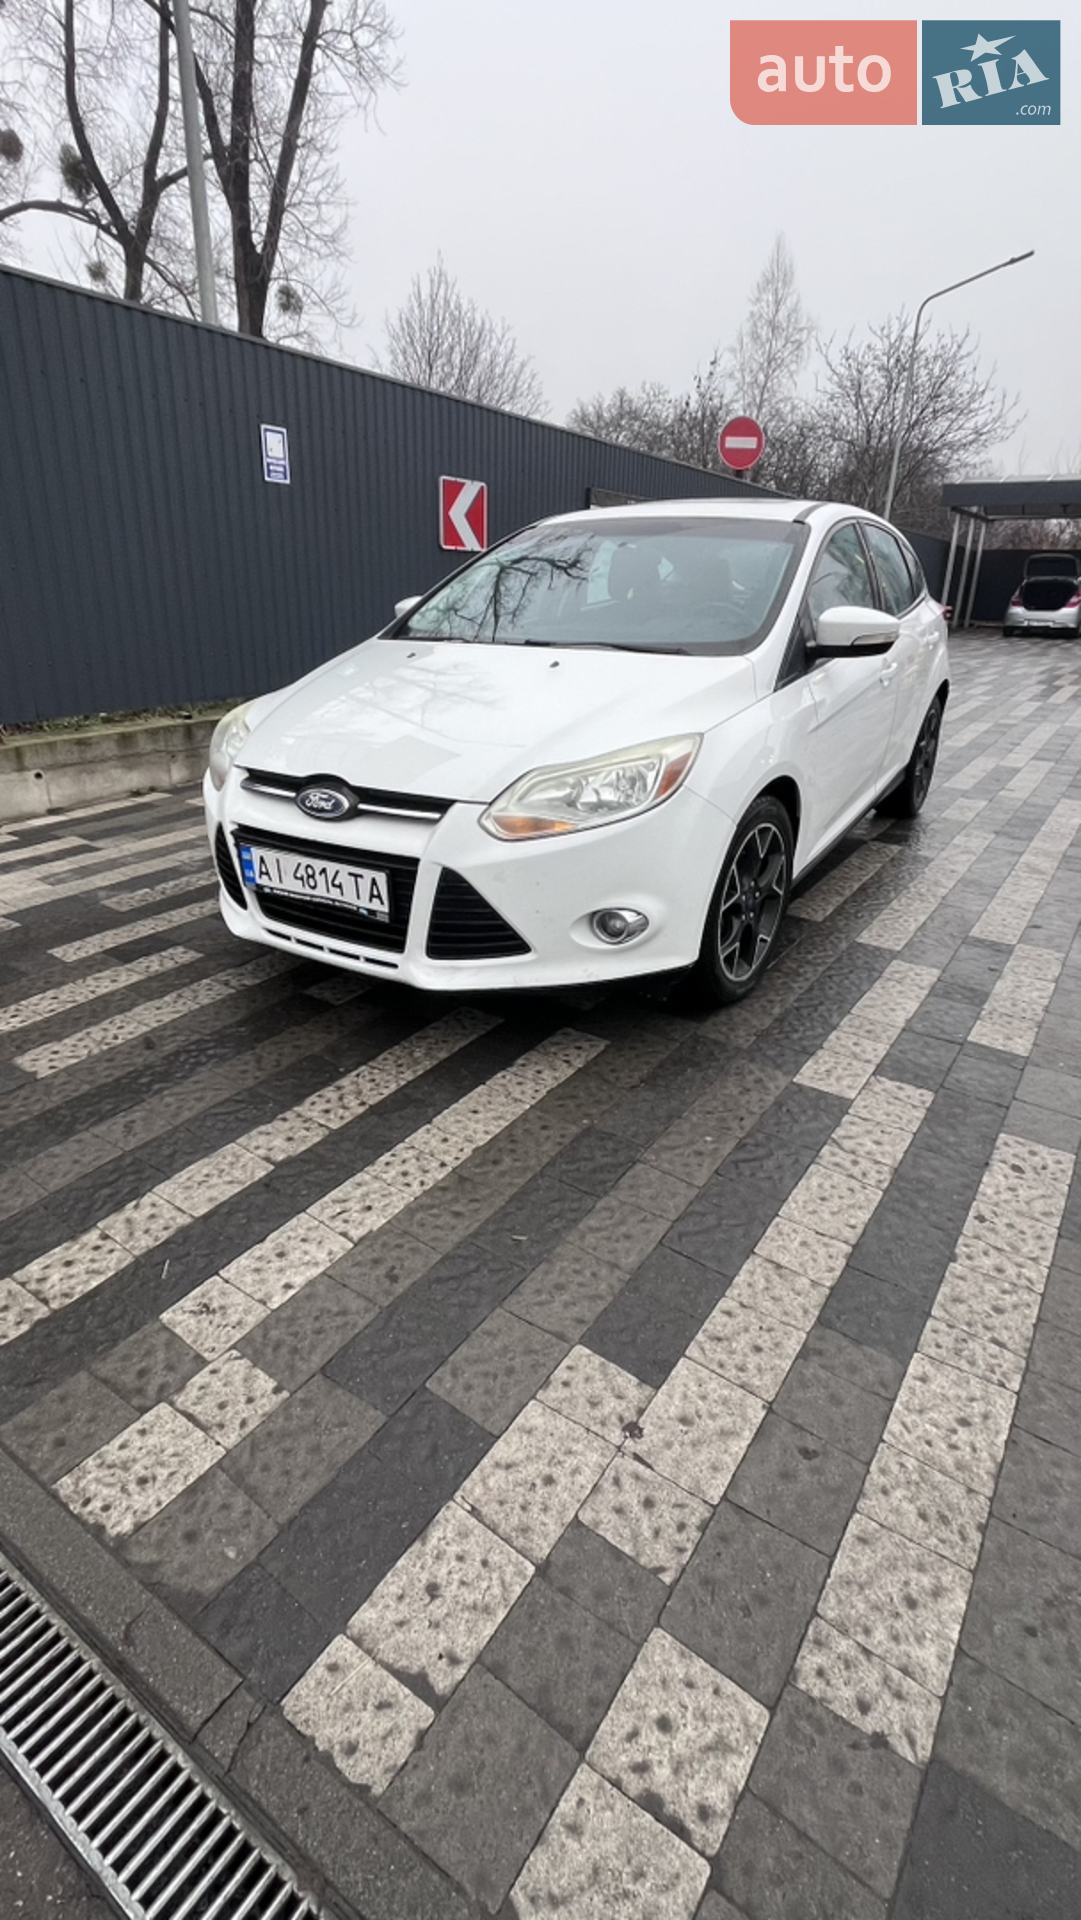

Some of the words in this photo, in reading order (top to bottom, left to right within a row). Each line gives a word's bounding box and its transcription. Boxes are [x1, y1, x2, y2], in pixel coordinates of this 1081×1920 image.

[305, 792, 335, 810] Ford
[259, 855, 283, 884] AI
[293, 861, 344, 897] 4814
[347, 871, 385, 906] TA
